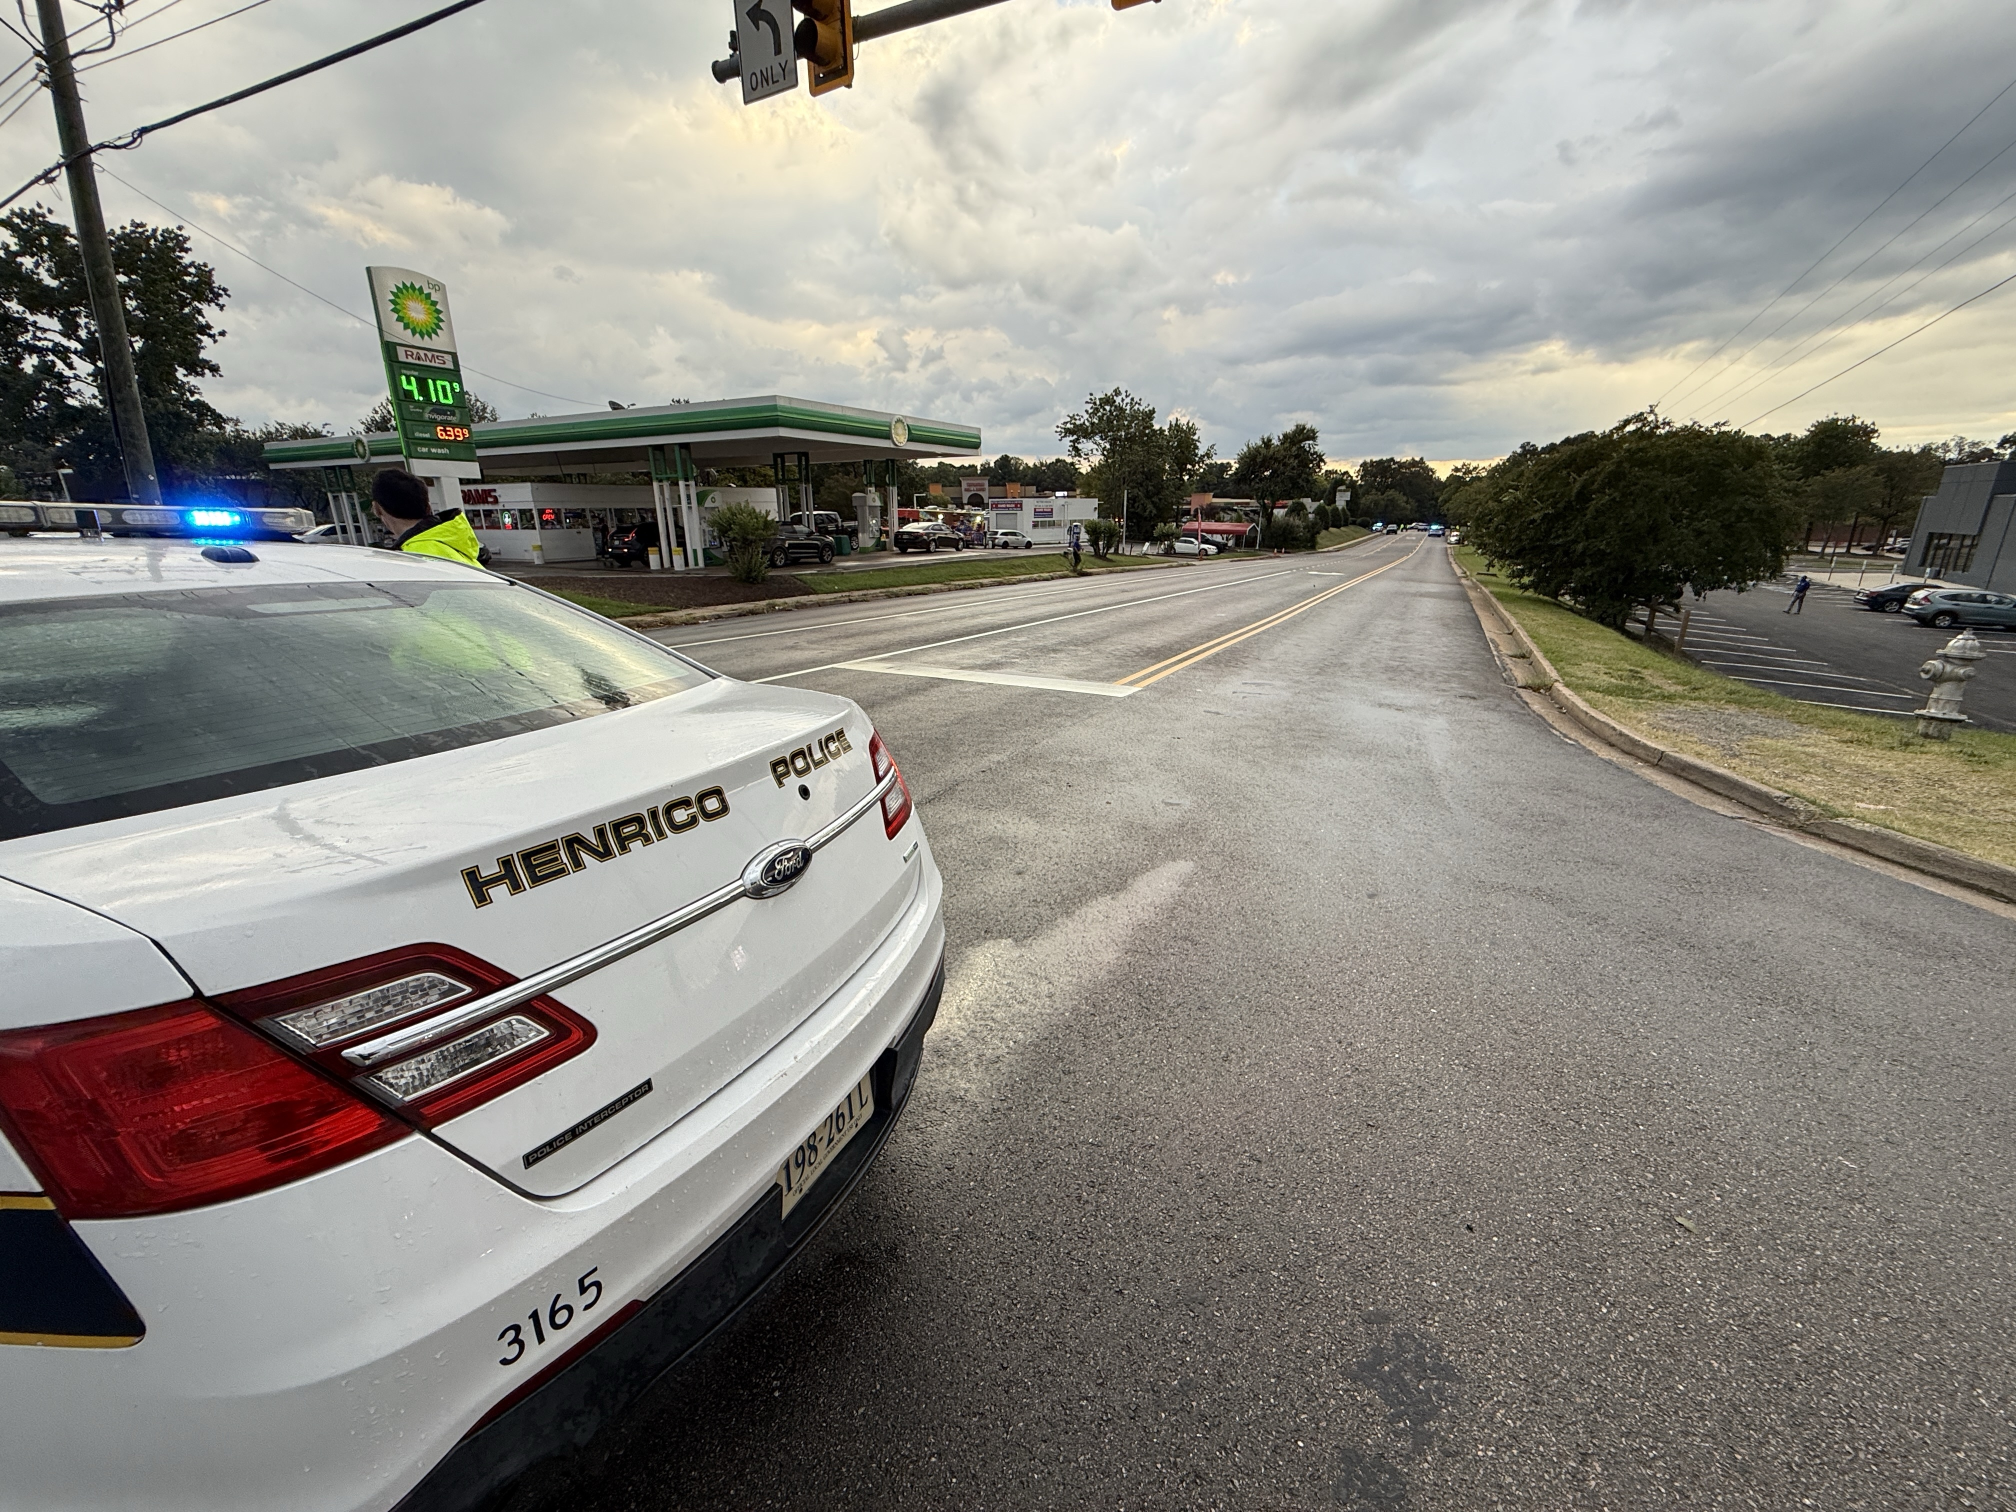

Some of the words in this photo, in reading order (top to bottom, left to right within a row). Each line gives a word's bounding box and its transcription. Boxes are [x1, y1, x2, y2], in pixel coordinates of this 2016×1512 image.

[749, 59, 789, 92] ONLY
[426, 279, 441, 294] bp
[404, 349, 447, 366] RAMS
[430, 447, 450, 455] wash
[769, 727, 853, 788] POLICE
[460, 785, 731, 910] HENRICO
[775, 850, 804, 881] Ford
[528, 1131, 573, 1164] POLICE
[575, 1083, 650, 1136] INTERCEPTOR
[496, 1266, 604, 1367] 3165
